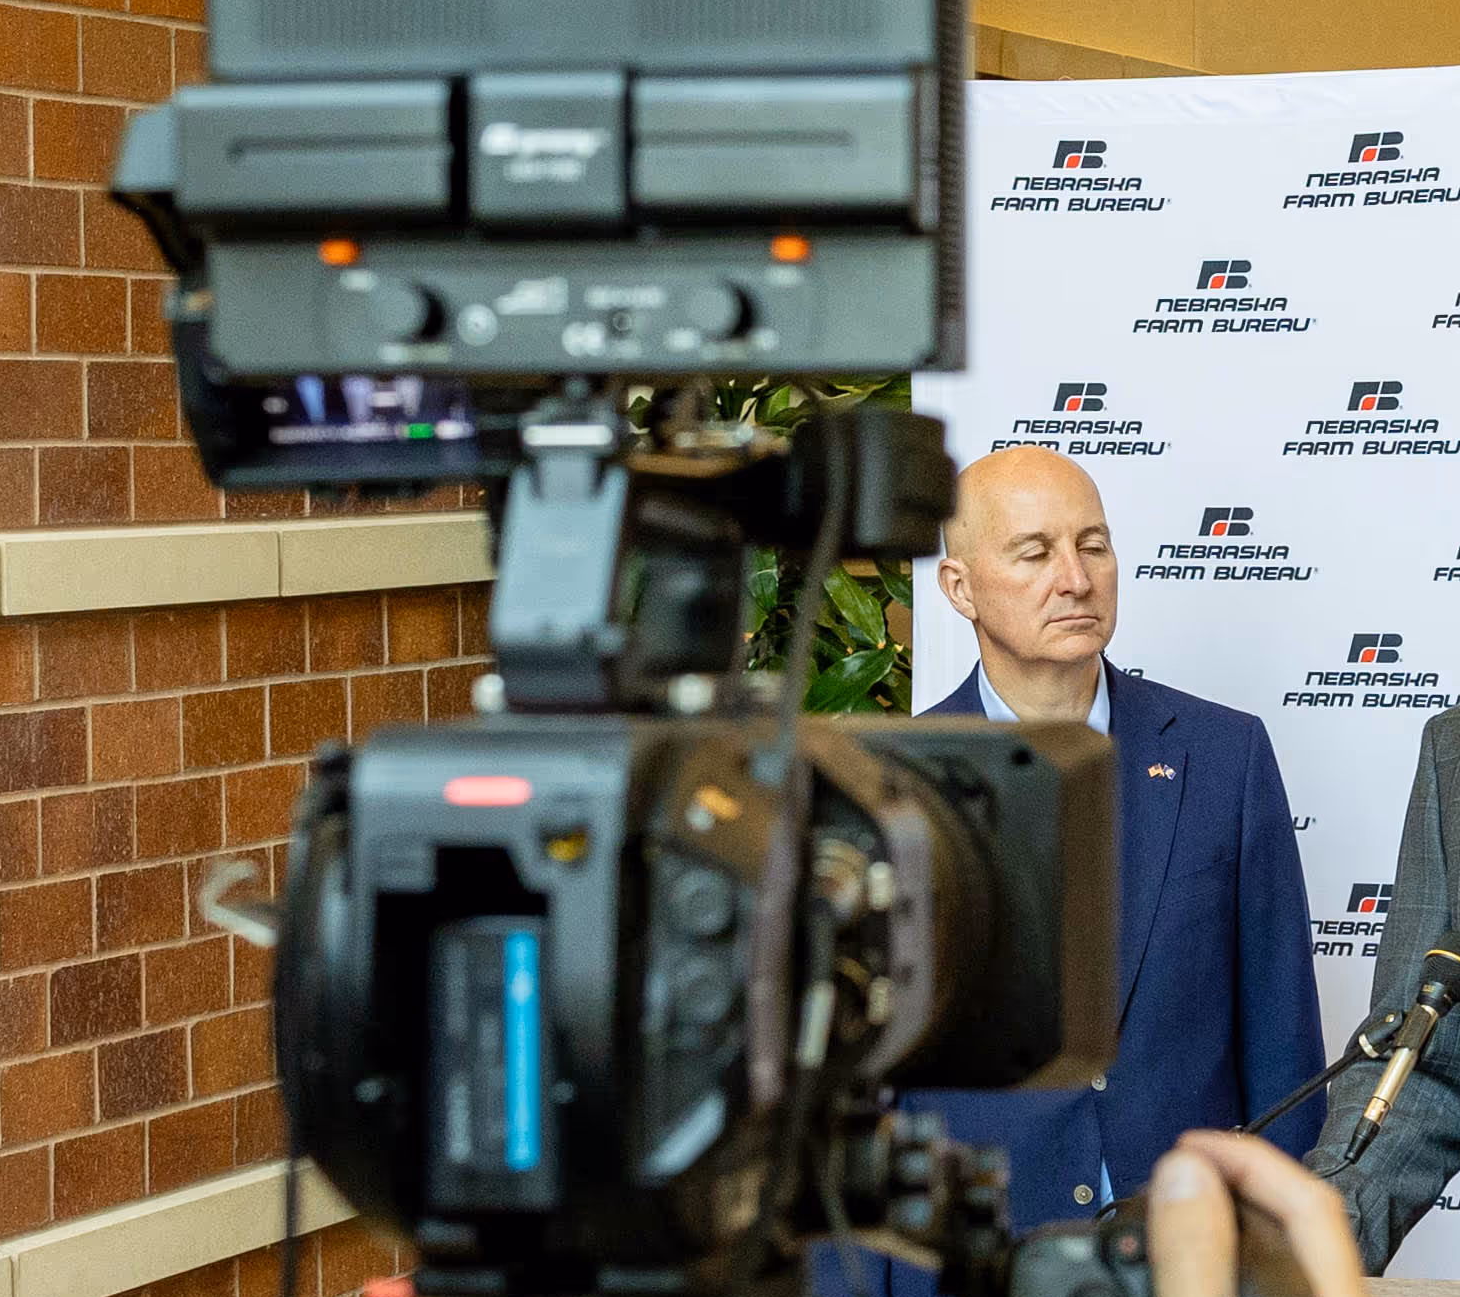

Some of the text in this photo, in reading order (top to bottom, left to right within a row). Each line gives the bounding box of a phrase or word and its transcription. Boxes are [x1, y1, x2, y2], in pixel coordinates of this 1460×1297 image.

[1013, 177, 1142, 191] NEBRASKA
[1306, 167, 1440, 187] NEBRASKA
[991, 198, 1165, 211] FARM BUREAU
[1283, 193, 1355, 209] FARM
[1156, 298, 1287, 312] NEBRASKA
[1133, 318, 1310, 333] FARM BUREAU
[1013, 420, 1142, 434] NEBRASKA
[1306, 419, 1439, 434] NEBRASKA
[1068, 441, 1165, 455] BUREAU
[1283, 442, 1354, 455] FARM
[1158, 545, 1289, 559] NEBRASKA
[1136, 565, 1312, 580] FARM BUREAU
[1305, 672, 1438, 687] NEBRASKA
[1283, 693, 1354, 707] FARM
[1313, 941, 1354, 957] ARM
